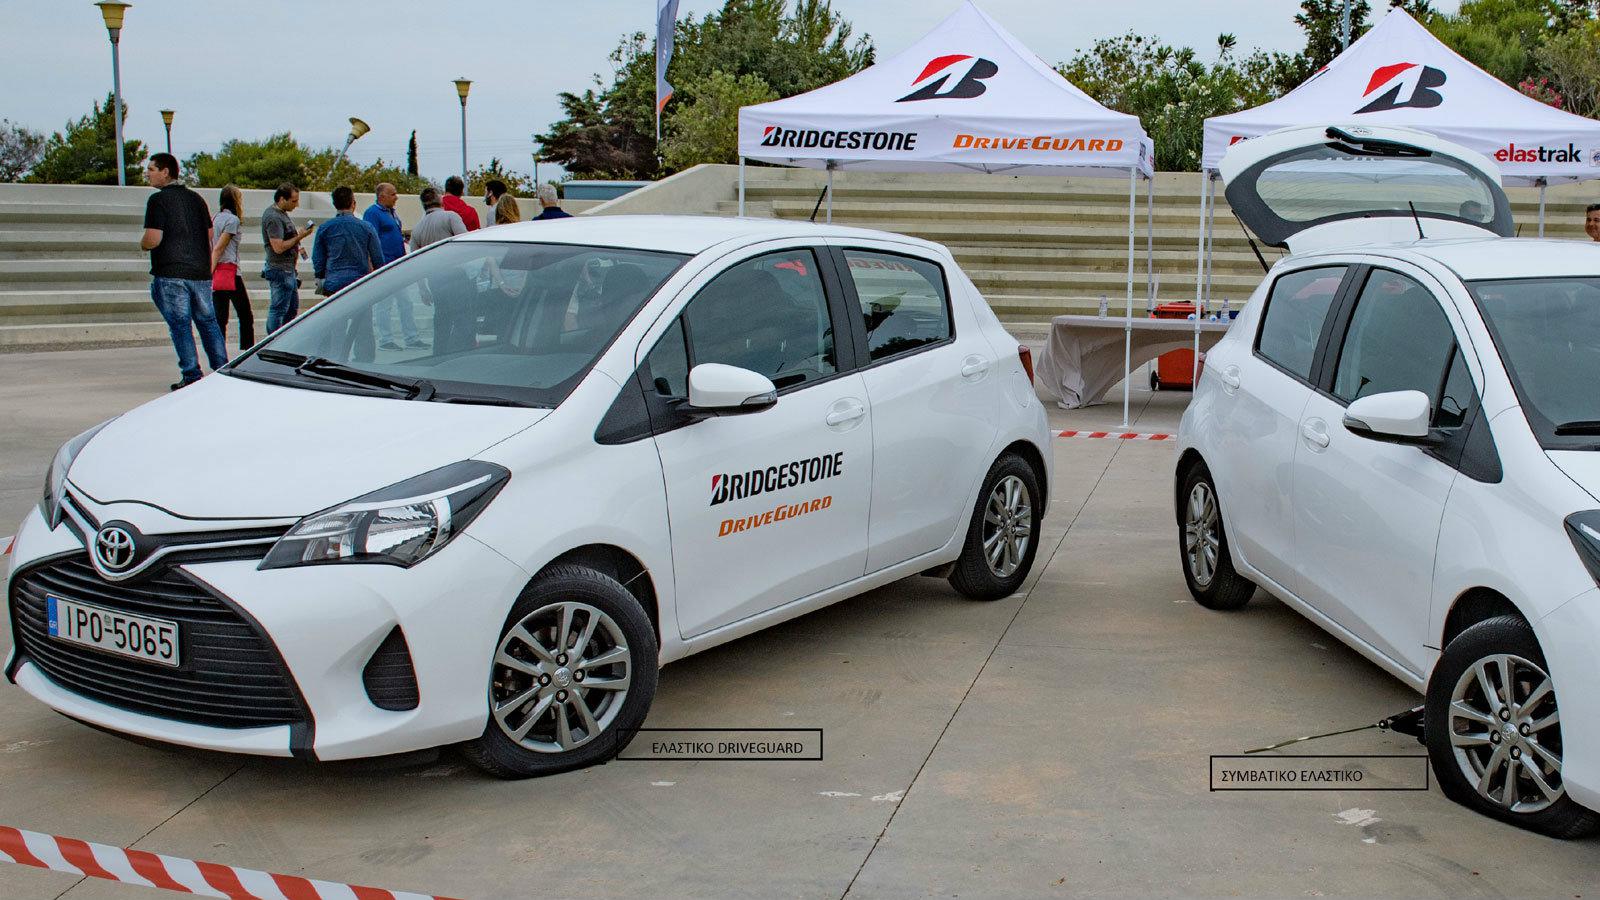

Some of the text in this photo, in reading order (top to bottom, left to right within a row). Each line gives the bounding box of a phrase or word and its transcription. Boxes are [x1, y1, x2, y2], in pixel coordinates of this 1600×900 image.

[761, 126, 918, 151] BRIDGESTONE
[952, 134, 1124, 152] DRIVEGUARD
[1494, 143, 1582, 162] elastrak
[710, 451, 843, 506] BRIDGESTONE
[718, 495, 832, 537] DRIVEGUARD
